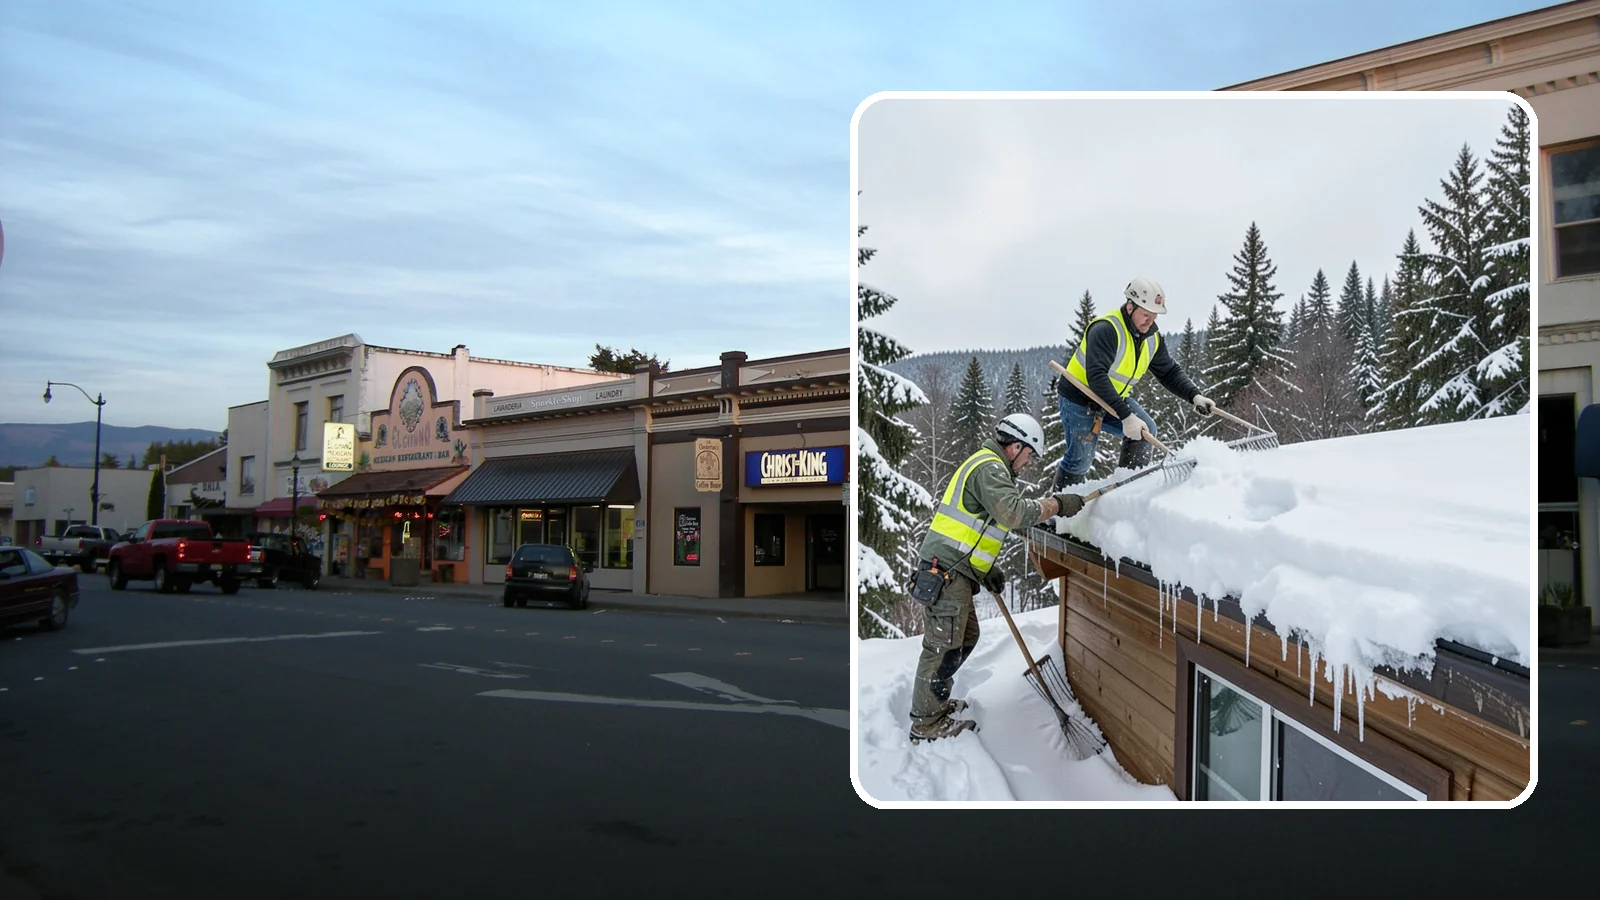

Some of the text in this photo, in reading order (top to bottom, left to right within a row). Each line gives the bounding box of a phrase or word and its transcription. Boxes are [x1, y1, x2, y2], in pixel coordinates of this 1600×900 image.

[596, 389, 623, 400] LAUNDRY
[493, 402, 522, 413] LAVANDERIA
[531, 394, 583, 409] Sparkle Shop
[373, 454, 396, 464] MEXICAN
[397, 451, 434, 462] RESTAURANT
[437, 450, 450, 459] BAR
